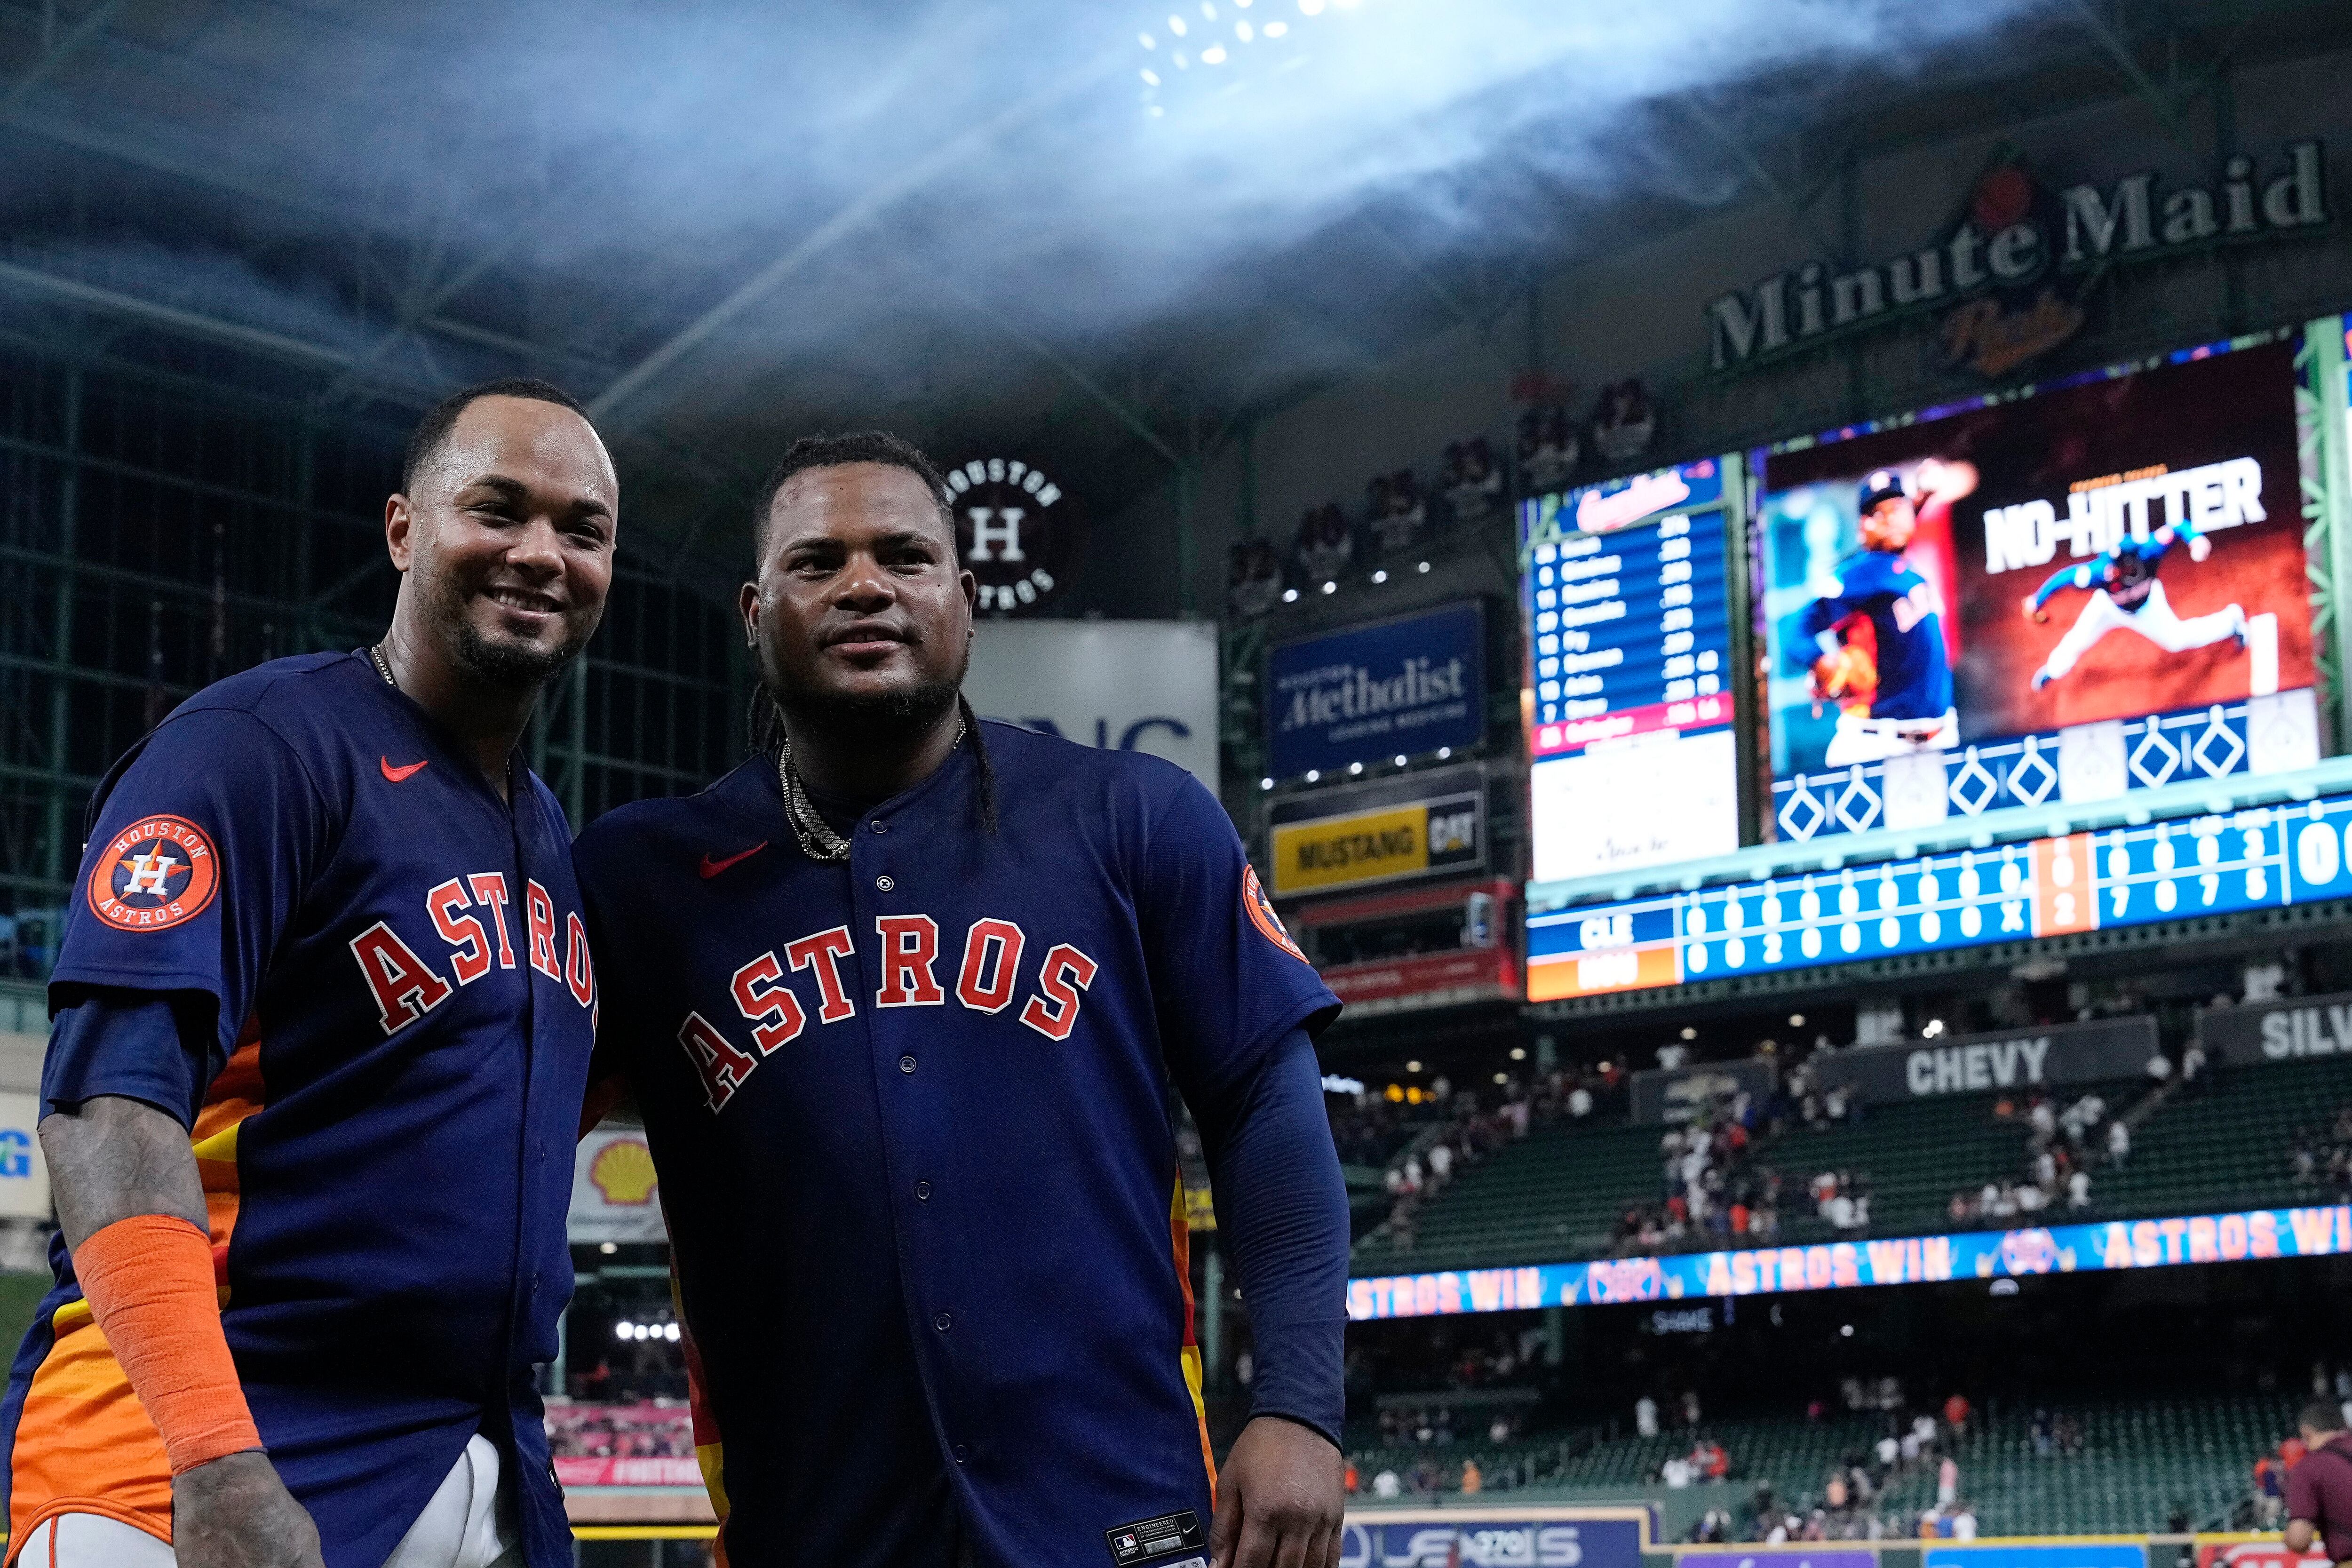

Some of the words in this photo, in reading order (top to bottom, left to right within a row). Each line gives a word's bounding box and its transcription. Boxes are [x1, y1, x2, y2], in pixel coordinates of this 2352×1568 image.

[1710, 217, 2039, 369] Minute
[2068, 143, 2326, 262] Maid
[968, 507, 1025, 562] H
[1983, 456, 2267, 574] NO-HITTER
[977, 568, 1054, 611] TROS
[1282, 656, 1466, 729] Methodist
[114, 822, 208, 859] HOUSTON
[1296, 825, 1415, 872] MUSTANG
[123, 854, 178, 896] H
[99, 897, 184, 924] ASTROS
[1580, 914, 1635, 952] CLE
[1763, 933, 1782, 963] 2
[2054, 893, 2075, 925] 2
[2111, 886, 2130, 917] 7
[2200, 874, 2219, 906] 7
[349, 871, 599, 1035] ASTRO
[677, 914, 1099, 1115] ASTROS
[1906, 1036, 2051, 1096] CHEVY
[1705, 1242, 1858, 1297] ASTROS
[1866, 1235, 1952, 1285] WIN
[2103, 1210, 2280, 1270] ASTROS
[1468, 1266, 1542, 1312] WIN
[1137, 1519, 1174, 1532] ENGINEERED
